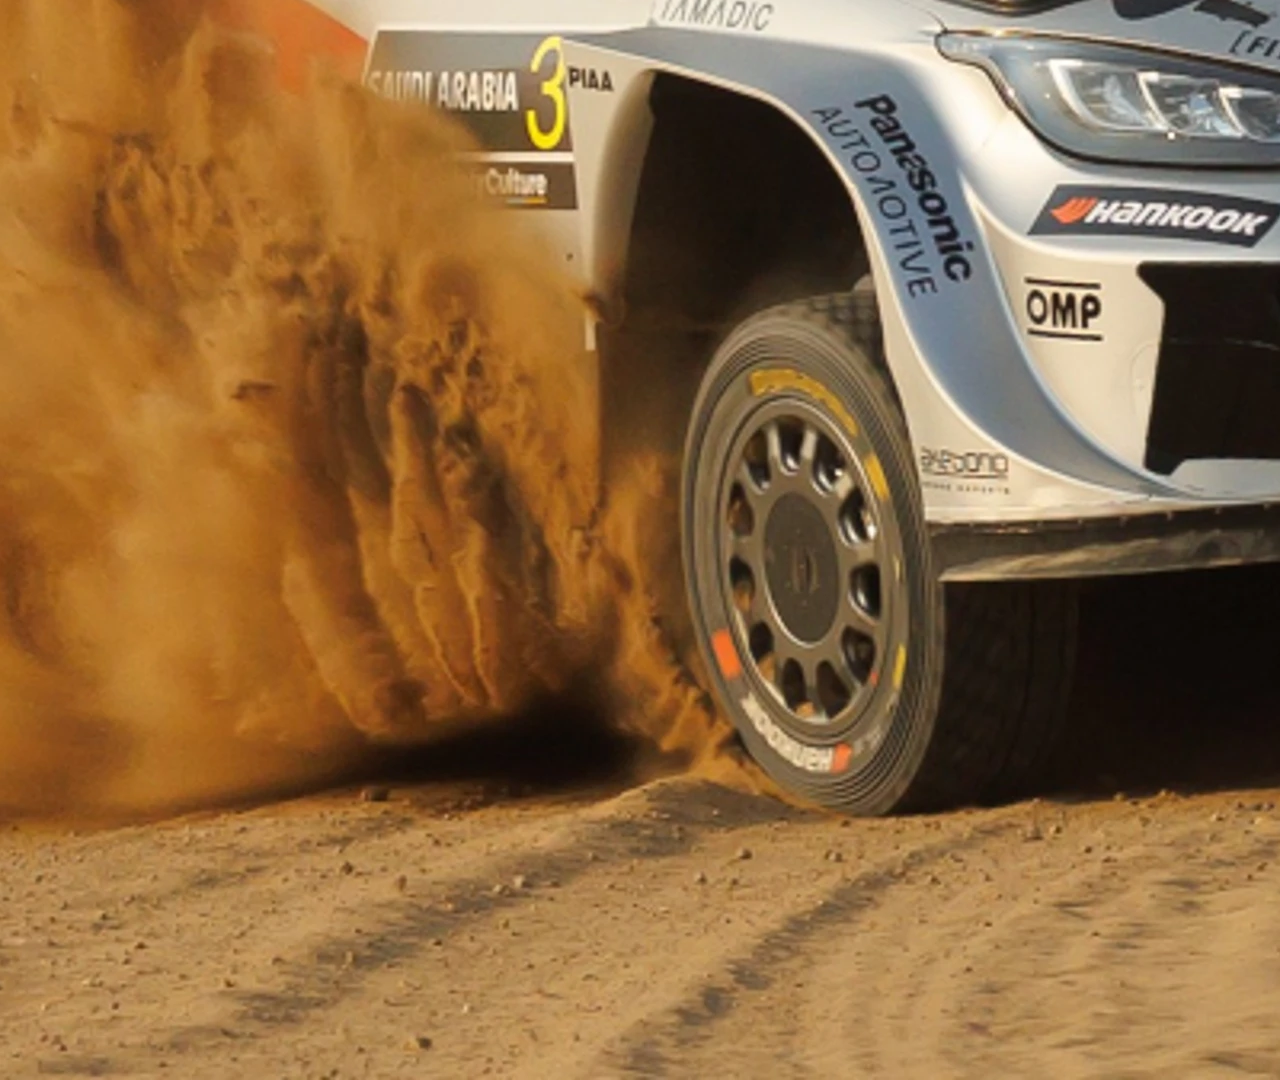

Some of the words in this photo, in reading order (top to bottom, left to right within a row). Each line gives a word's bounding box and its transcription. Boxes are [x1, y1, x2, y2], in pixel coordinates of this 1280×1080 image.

[437, 71, 519, 111] ARABIA
[526, 36, 566, 150] 3
[568, 66, 614, 92] PIAA
[485, 168, 548, 195] Culture
[854, 94, 974, 283] Panasonic
[811, 106, 939, 299] AUTOMOTIVE
[1026, 289, 1102, 330] OMP
